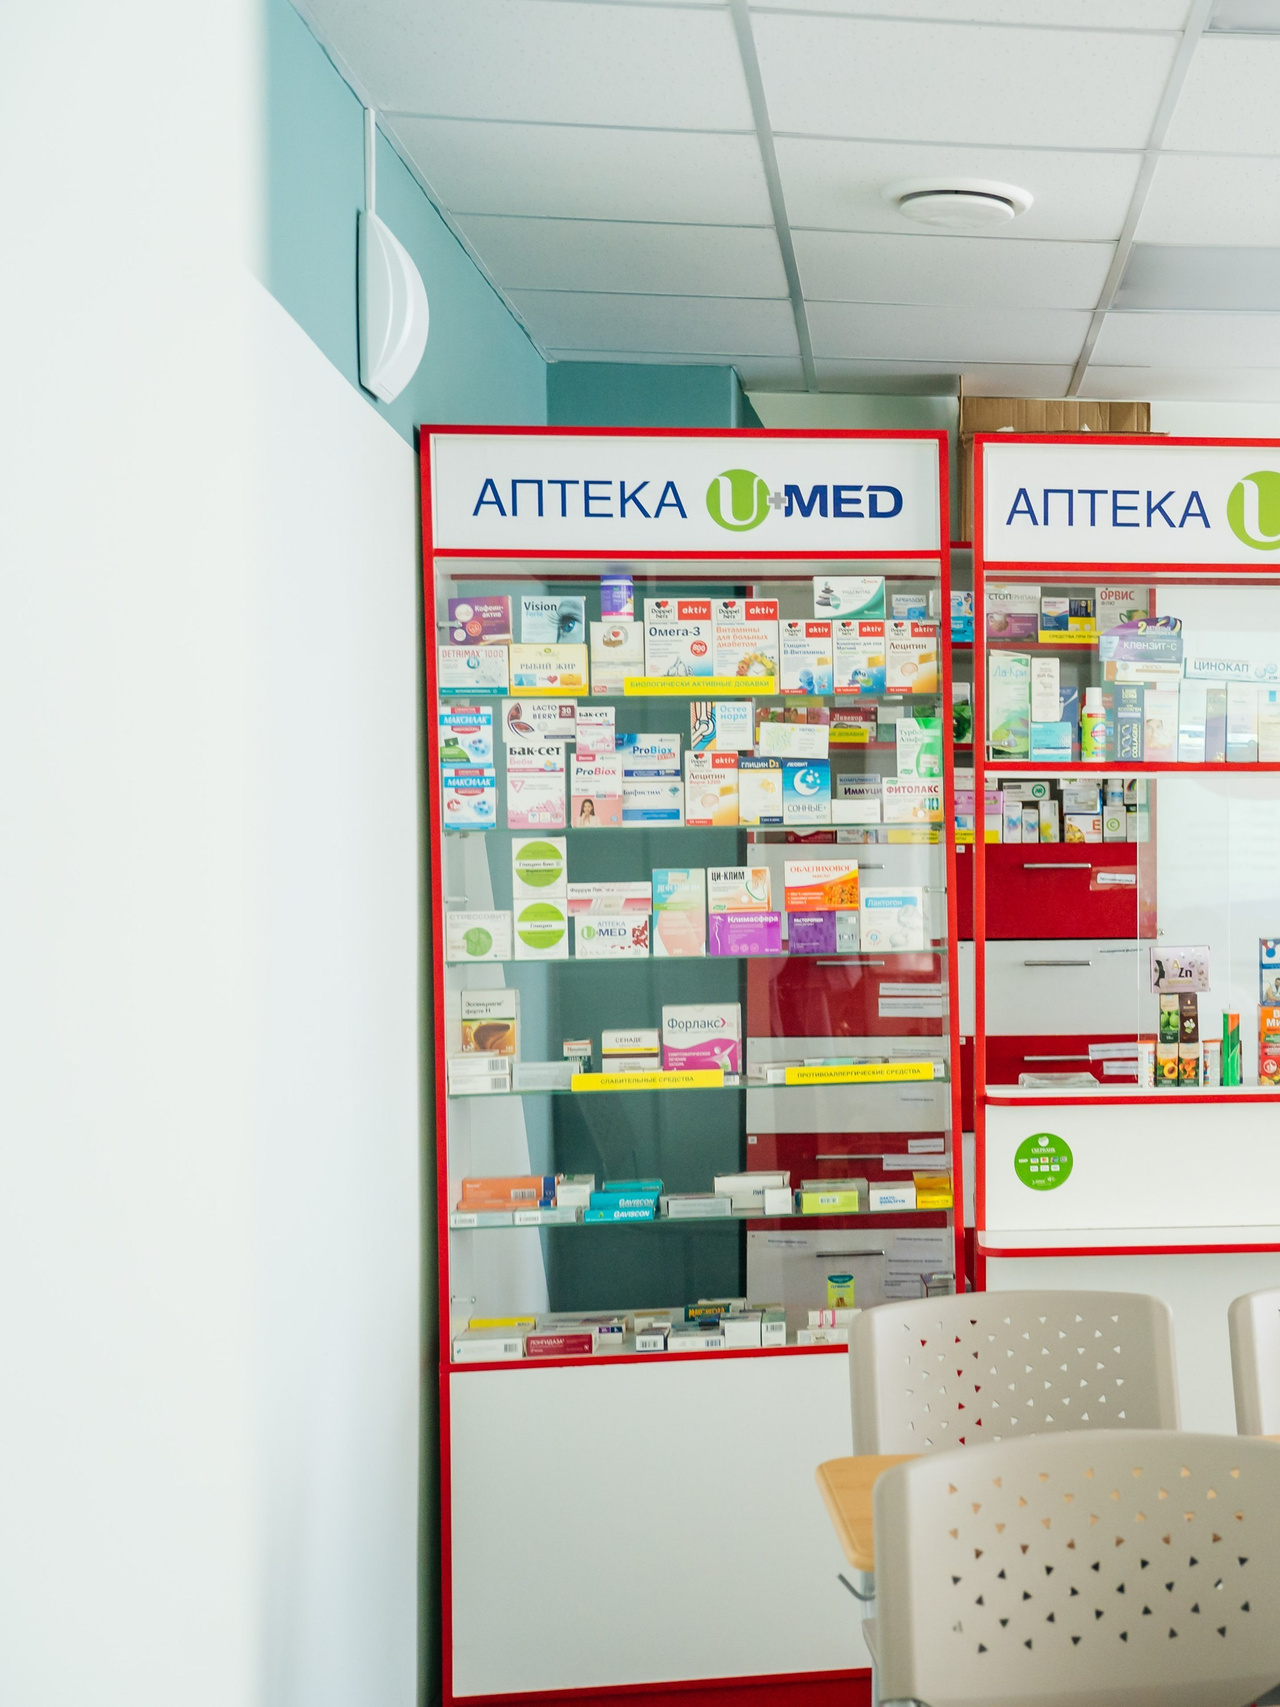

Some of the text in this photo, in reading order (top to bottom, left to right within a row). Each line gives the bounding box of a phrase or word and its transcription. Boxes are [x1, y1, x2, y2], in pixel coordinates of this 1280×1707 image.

[472, 478, 688, 519] АПТЕКА
[1006, 488, 1211, 528] АПТЕКА
[1100, 589, 1135, 601] ОРВИС
[523, 601, 557, 611] Vision
[682, 606, 708, 615] aktiv
[749, 606, 775, 615] aktiv
[649, 626, 701, 637] Омега-3
[1138, 622, 1146, 635] 2
[889, 642, 927, 650] Лецитин
[442, 649, 504, 658] DETRIMAX 1000
[1194, 660, 1249, 673] ЦИНОКАП
[993, 665, 1027, 678] Ла-Кри
[734, 680, 770, 688] ДОБАВКИ
[561, 707, 572, 715] 30
[720, 705, 747, 713] Остео
[443, 716, 487, 725] МАКСИЛАК
[720, 713, 748, 722] норм
[632, 746, 672, 755] ProBiox
[715, 757, 736, 765] aktiv
[575, 767, 616, 776] ProBiox
[447, 778, 492, 787] МАКСИЛАК
[886, 785, 939, 793] ФИТОЛАКС
[787, 804, 822, 813] СОННЫЕ
[789, 864, 851, 873] ОБЛЕПИХОВОЕ
[711, 870, 745, 881] ЦИ-КЛИМ
[867, 898, 903, 908] Лактогон
[727, 915, 779, 924] Климасфера
[1178, 967, 1193, 978] Zn
[667, 1016, 720, 1031] Форлакс
[797, 1067, 921, 1079] ПРОТИВОАЛЛЕРГИЧЕСКИЕ СРЕДСТВА
[619, 1198, 655, 1207] GAVISCON
[613, 1210, 650, 1218] GAVISCON
